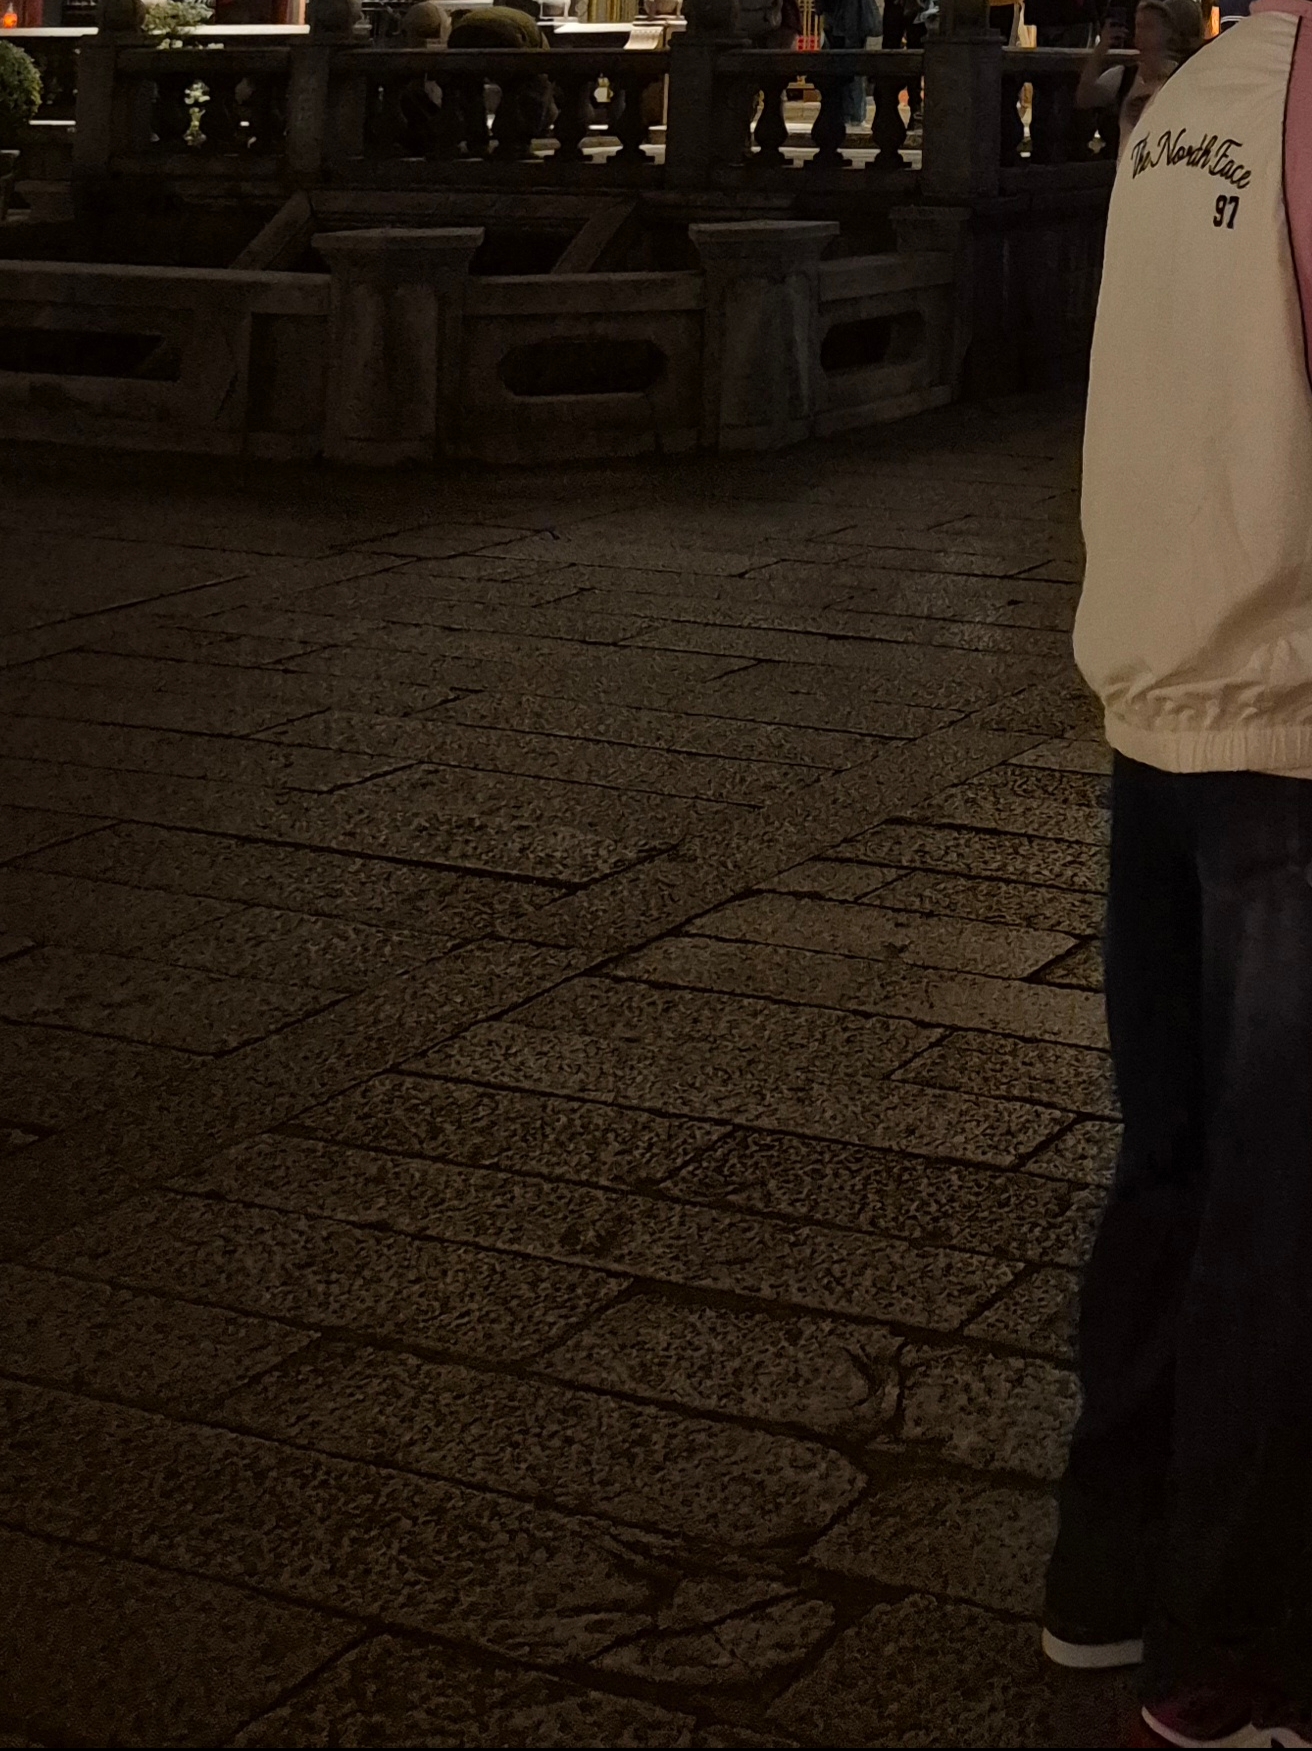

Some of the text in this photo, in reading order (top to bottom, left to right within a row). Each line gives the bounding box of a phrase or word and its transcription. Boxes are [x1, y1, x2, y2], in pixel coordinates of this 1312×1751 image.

[1131, 127, 1252, 190] The North Face
[1212, 194, 1240, 230] 97
